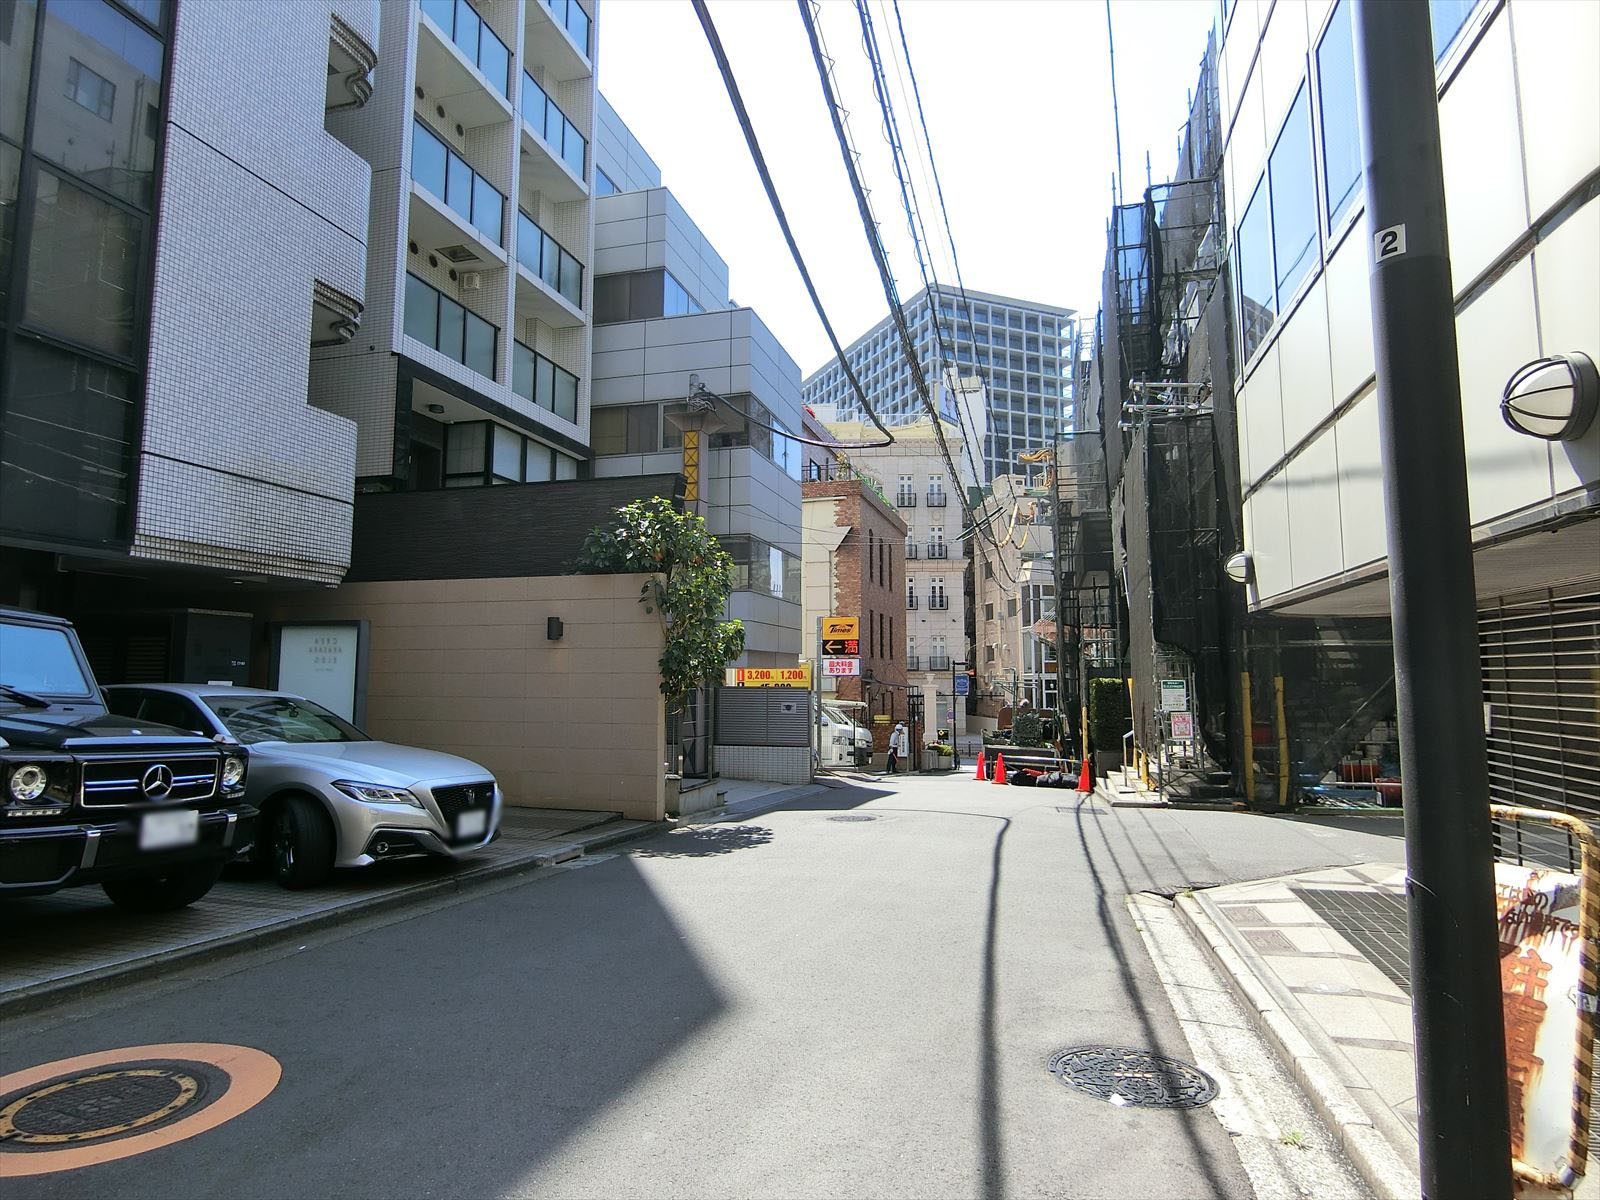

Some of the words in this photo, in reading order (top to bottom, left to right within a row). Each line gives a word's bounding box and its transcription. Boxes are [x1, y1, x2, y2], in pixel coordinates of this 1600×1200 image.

[1381, 231, 1398, 257] 2
[828, 623, 855, 634] Times
[844, 640, 859, 654] 満
